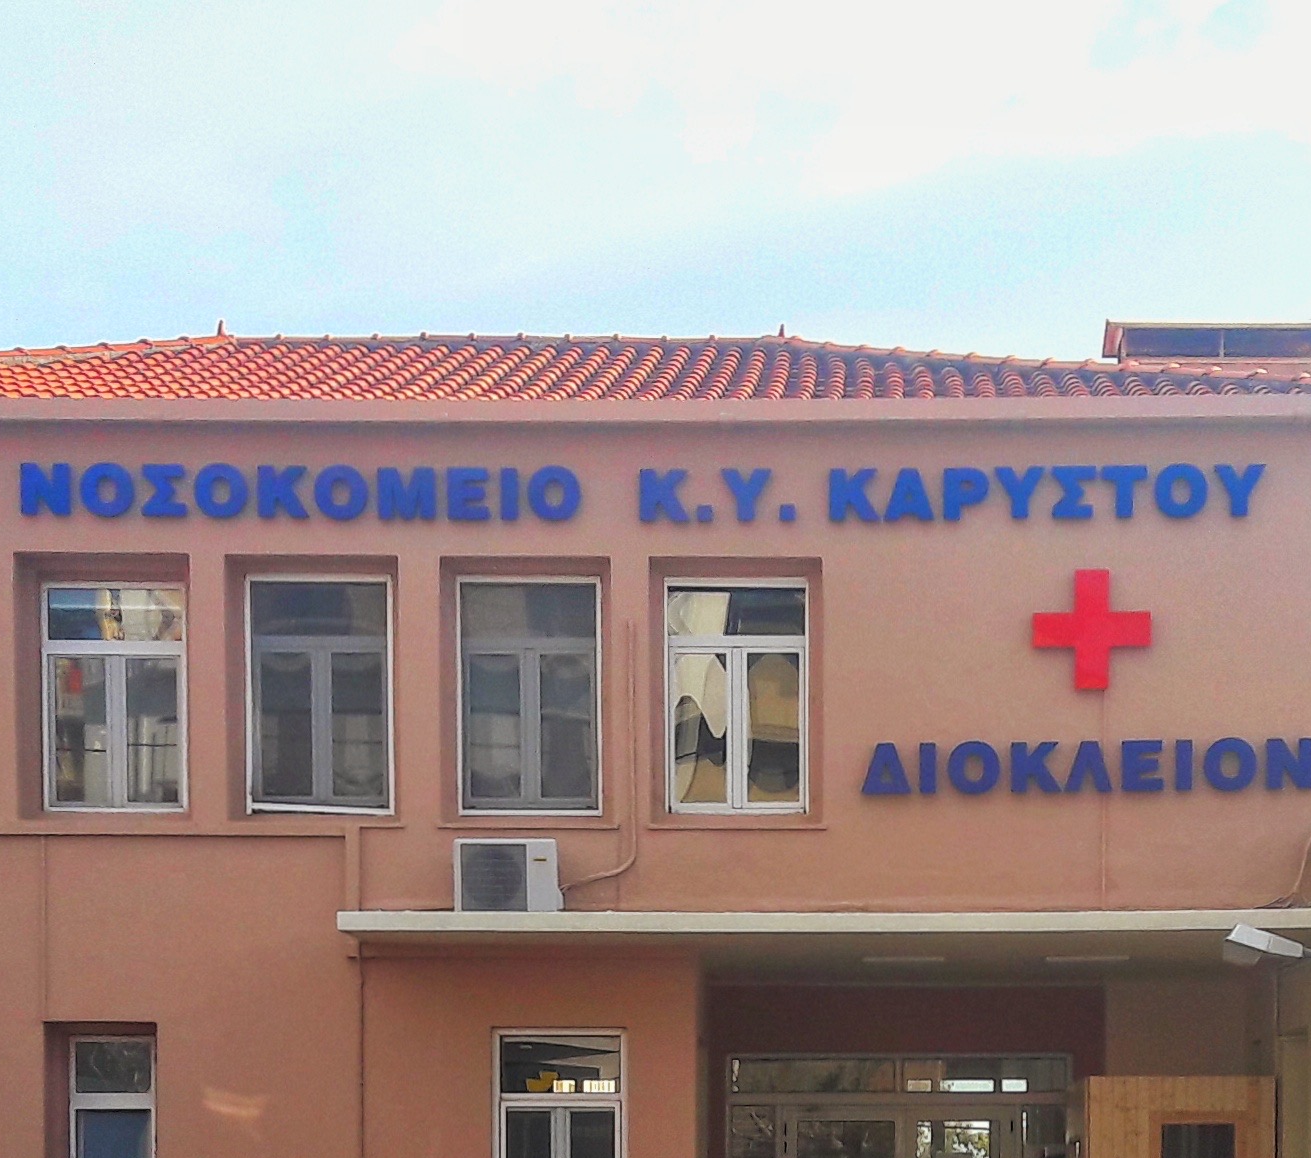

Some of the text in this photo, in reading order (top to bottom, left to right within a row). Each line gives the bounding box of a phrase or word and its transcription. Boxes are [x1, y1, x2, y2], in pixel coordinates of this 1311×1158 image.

[19, 462, 582, 521] ΝΟΣΟΚΟΜΕΙΟ
[639, 468, 797, 523] Κ.Υ.
[827, 463, 1267, 522] ΚΑΡΥΣΤΟΥ
